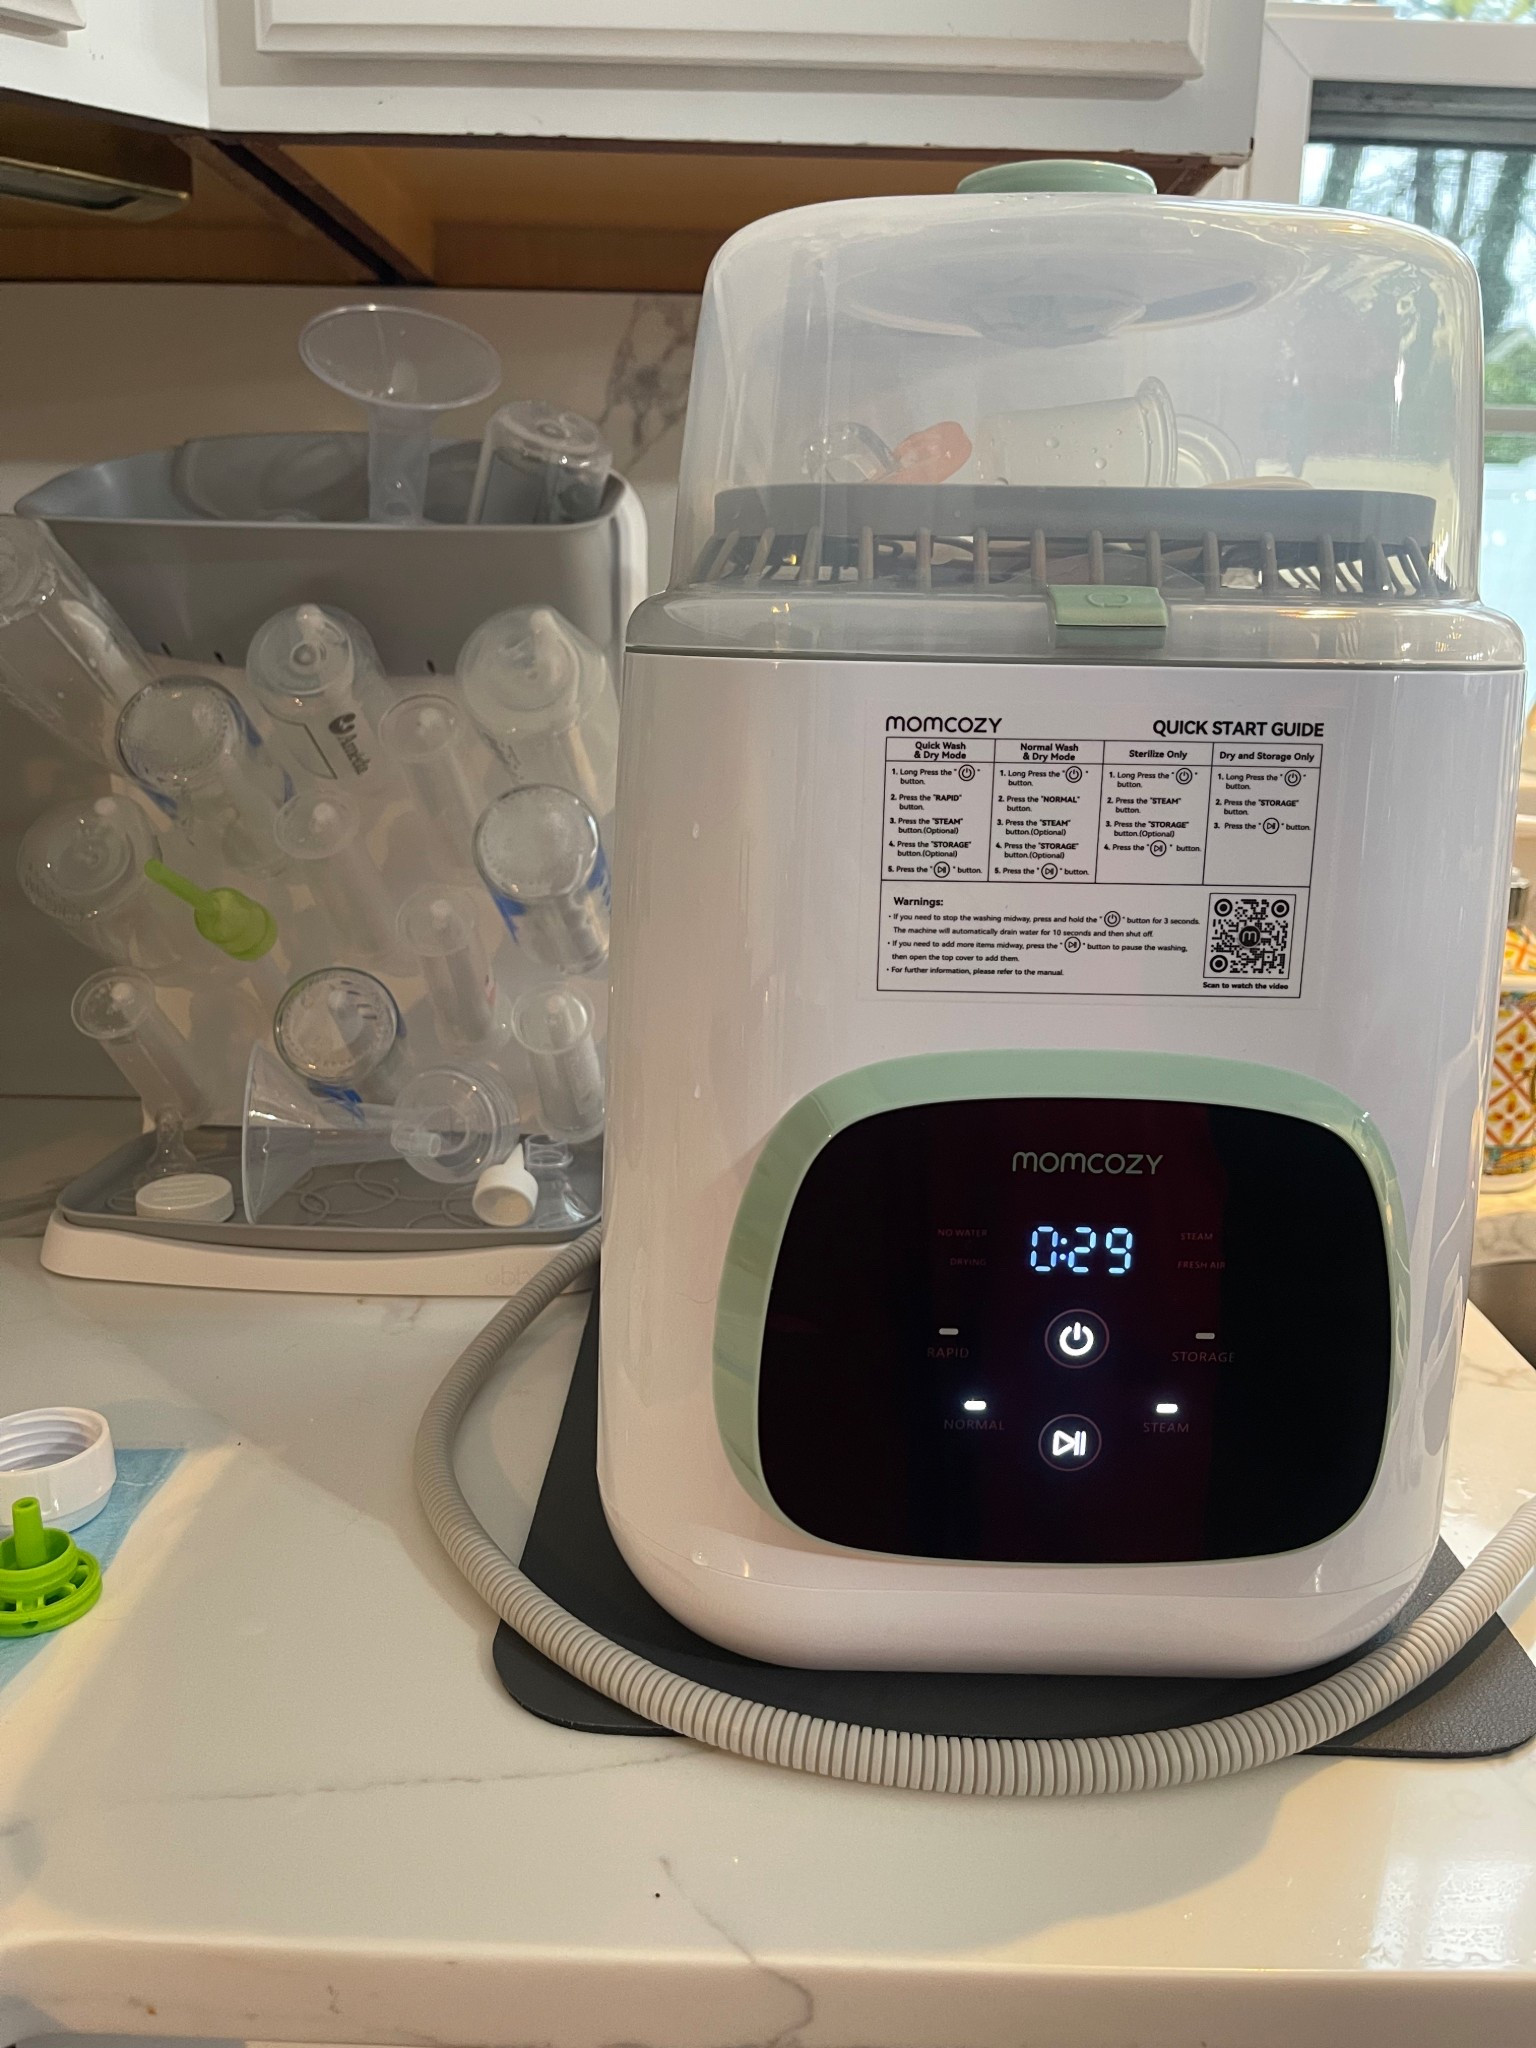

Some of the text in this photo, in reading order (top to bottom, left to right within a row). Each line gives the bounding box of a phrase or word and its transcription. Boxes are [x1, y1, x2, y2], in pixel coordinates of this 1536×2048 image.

[1153, 720, 1324, 737] QUICK START GUIDE
[915, 741, 966, 751] Quick Wash
[1020, 743, 1079, 751] Normal Wash
[914, 750, 966, 762] & Dry Mode
[1022, 752, 1075, 764] & Dry Mode
[1129, 749, 1188, 760] Sterilize Only
[1220, 751, 1315, 763] Dry and Storage Only
[900, 768, 918, 777] Long
[920, 768, 939, 776] Press
[1008, 770, 1026, 779] Long
[1117, 772, 1136, 780] Long
[1226, 773, 1244, 782] Long
[1246, 773, 1265, 781] Press
[1114, 820, 1133, 828] Press
[897, 840, 916, 848] Press
[896, 865, 915, 873] Press
[893, 897, 943, 908] Warnings:
[973, 915, 1002, 923] washing
[952, 928, 998, 936] automatically
[1063, 930, 1091, 938] seconds
[937, 1228, 988, 1238] NO WATER
[1179, 1232, 1214, 1241] STEAM
[1029, 1225, 1134, 1274] 0:29
[949, 1257, 987, 1266] DRYING
[1177, 1261, 1226, 1269] FRESH AIR
[926, 1347, 970, 1359] RAPID
[1170, 1351, 1236, 1363] STORAGE
[943, 1419, 1005, 1431] NORMAL
[1143, 1422, 1190, 1434] STEAM
